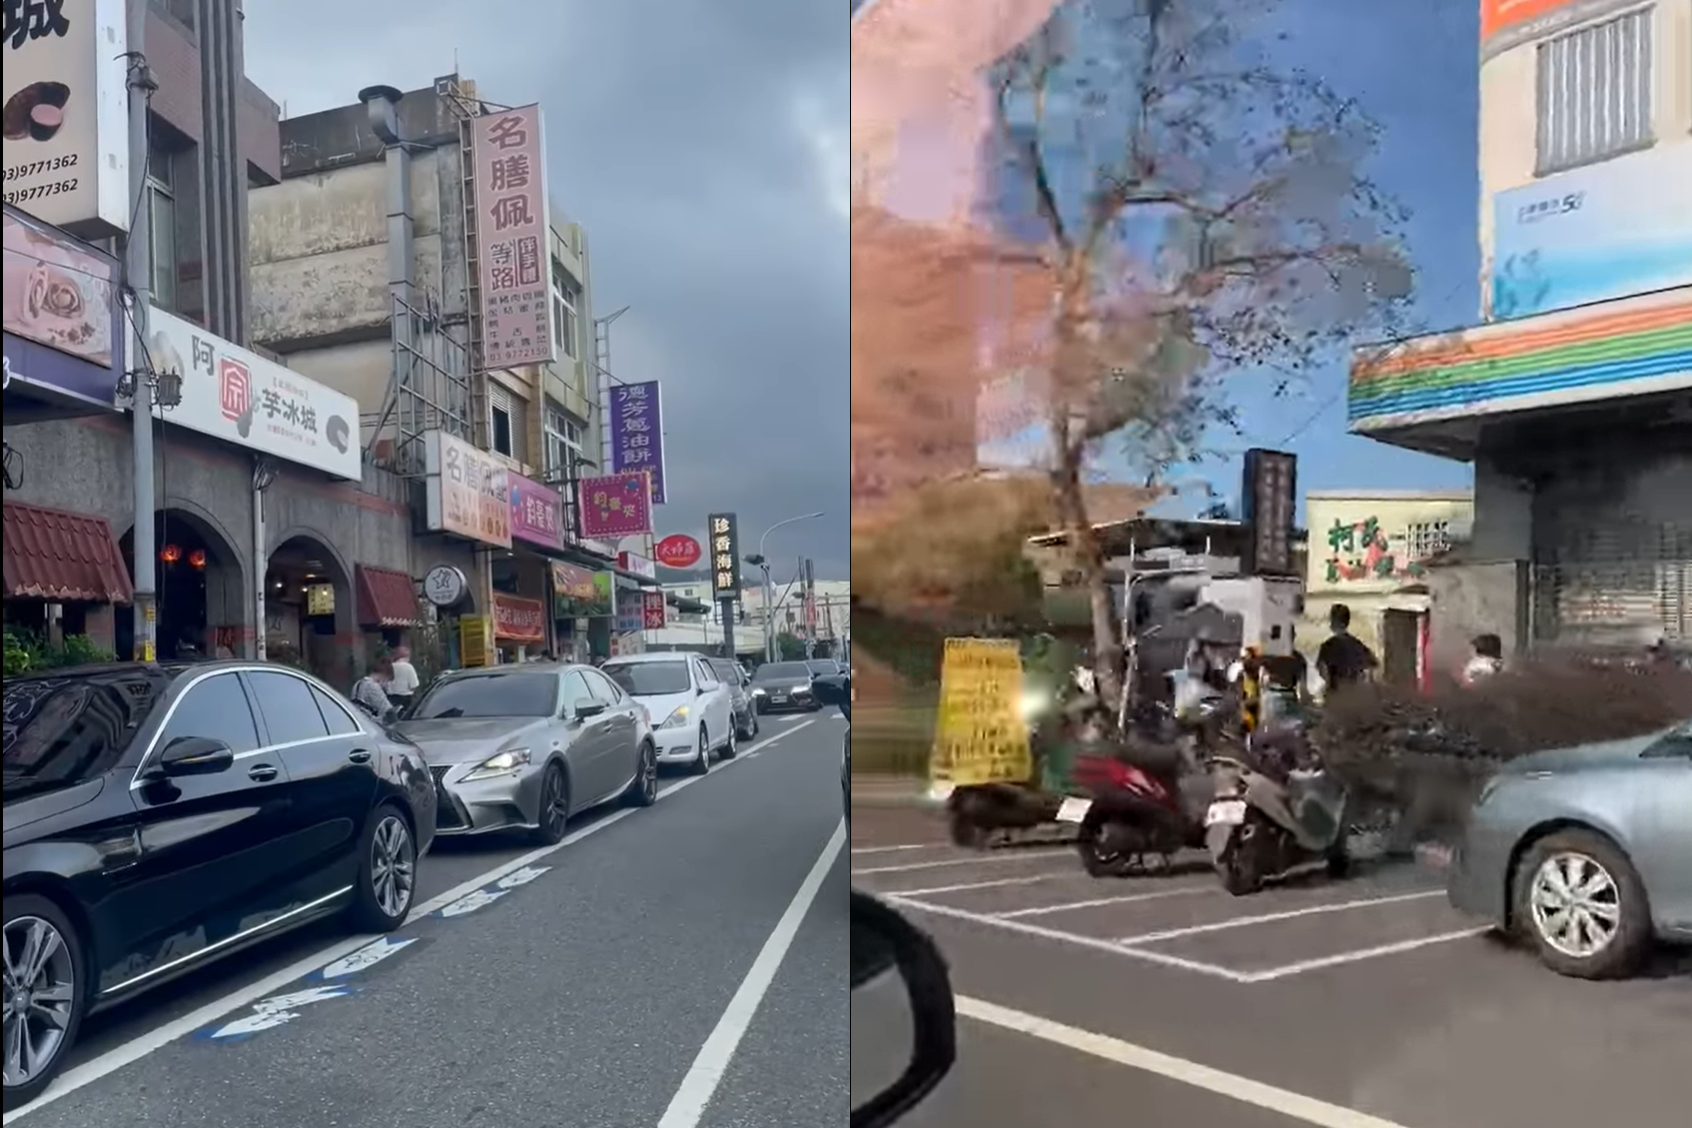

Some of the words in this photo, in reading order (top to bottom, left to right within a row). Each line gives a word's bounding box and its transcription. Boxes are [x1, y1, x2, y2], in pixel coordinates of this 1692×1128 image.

[488, 116, 534, 231] 名膳佩
[713, 517, 734, 588] 珍香海鮮
